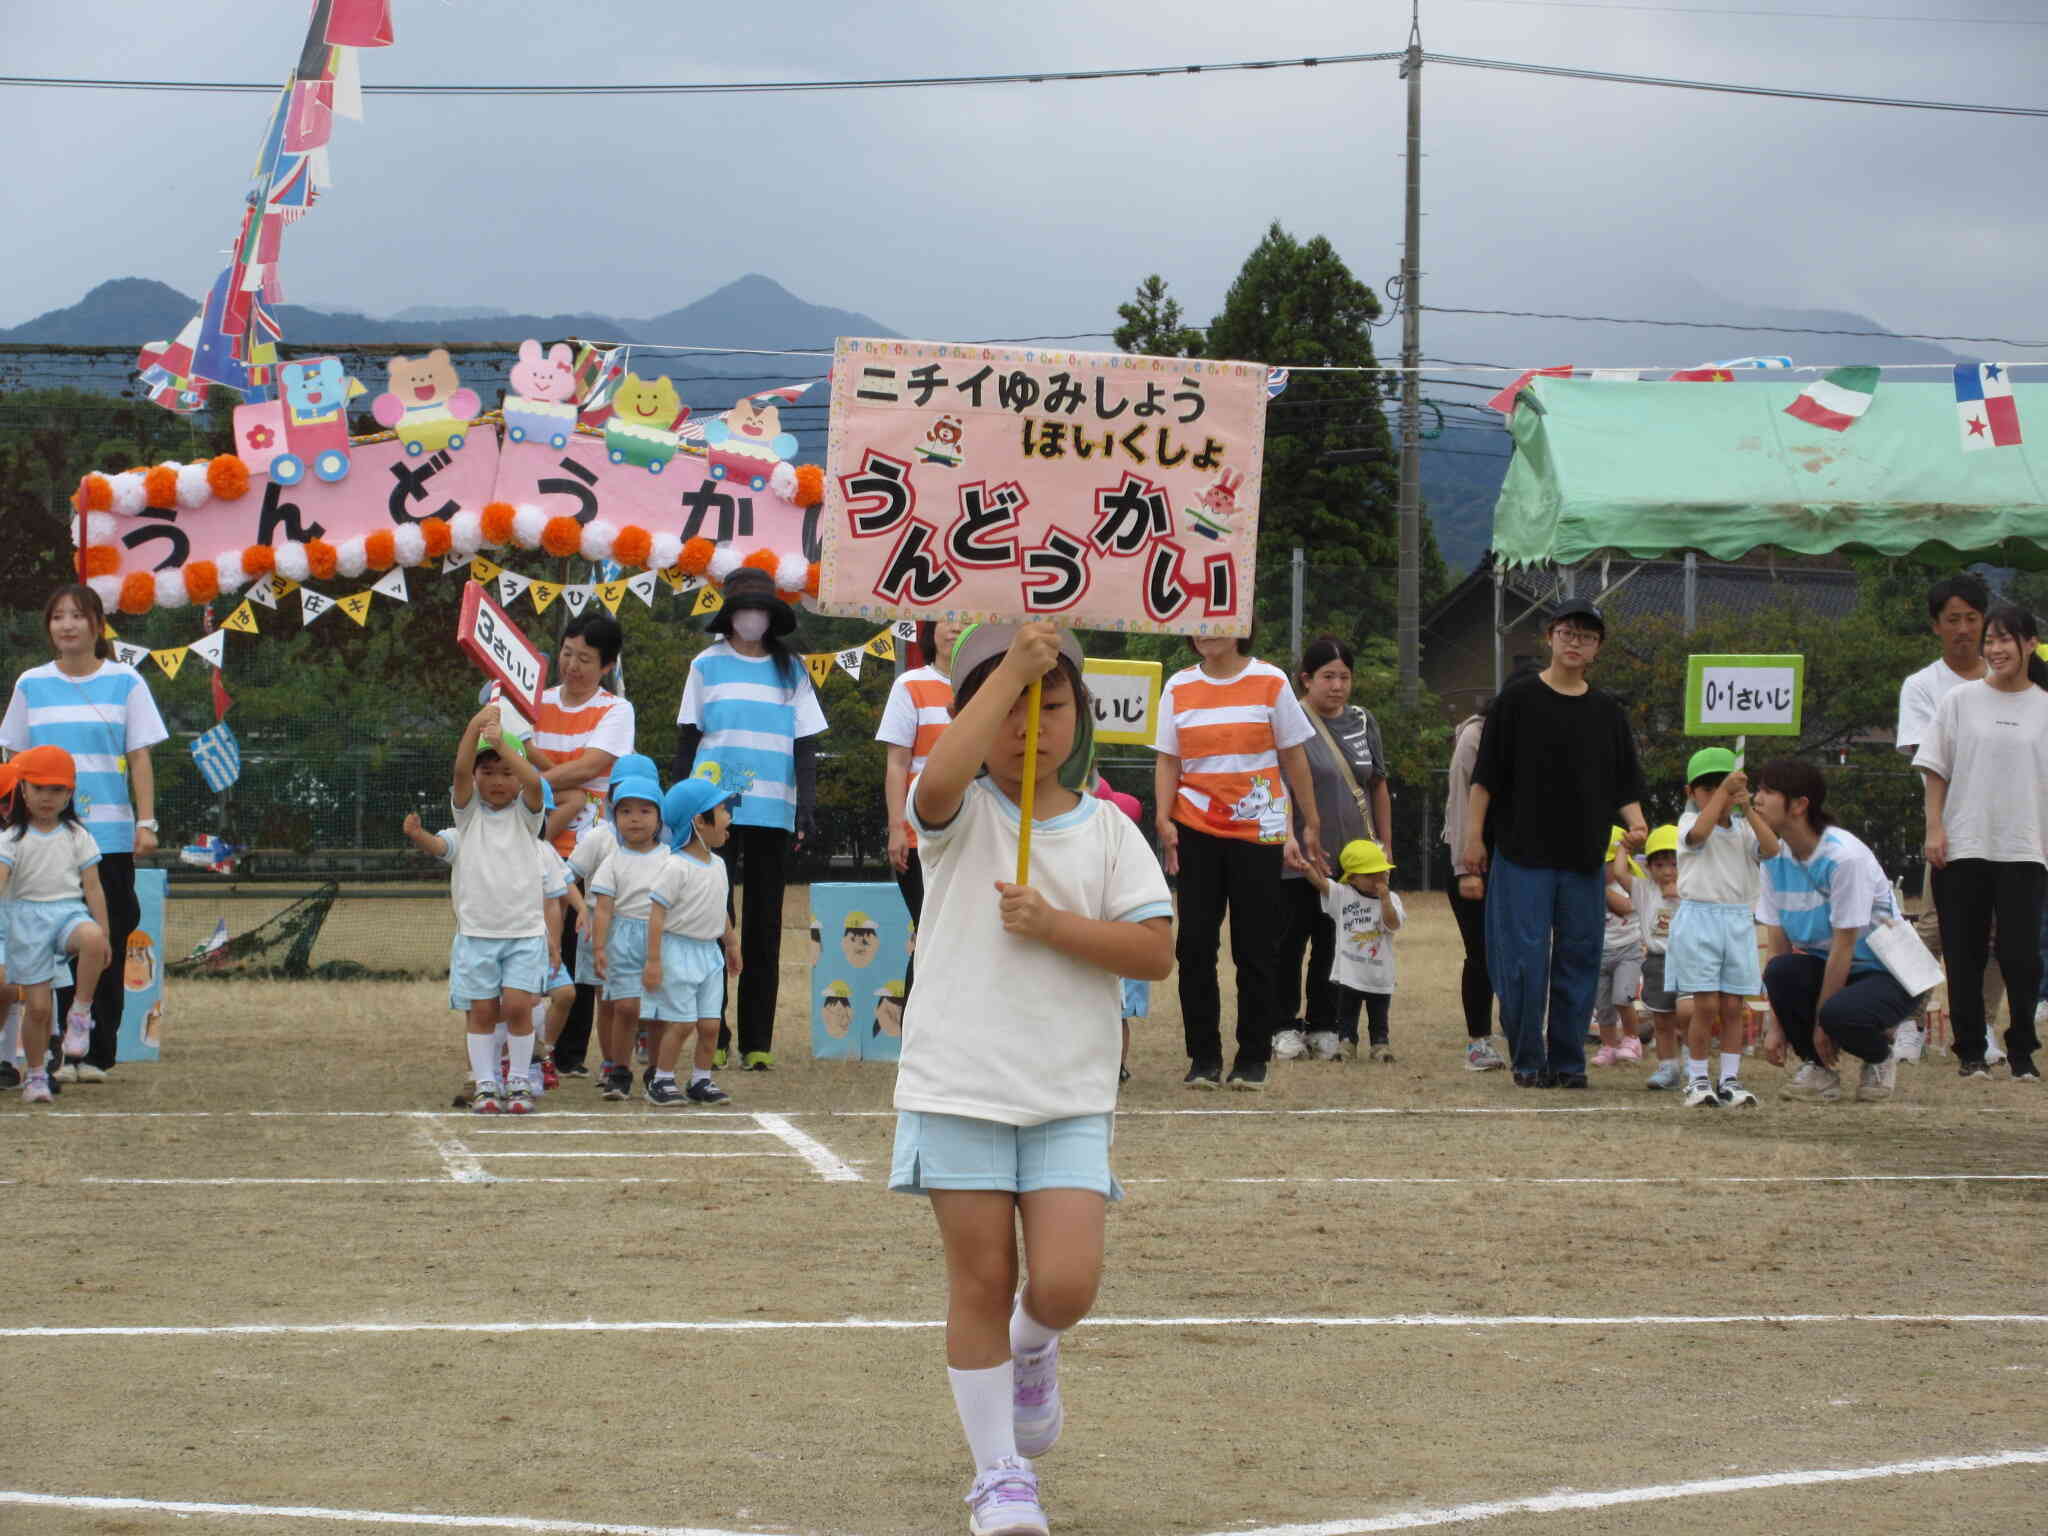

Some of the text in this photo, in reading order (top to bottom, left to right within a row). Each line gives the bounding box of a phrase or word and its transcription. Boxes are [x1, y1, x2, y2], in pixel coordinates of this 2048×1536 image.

[857, 363, 1206, 423] ニチイゆみしょう
[1022, 418, 1225, 470] ほいくしょ
[839, 447, 1237, 623] うんどうかい
[477, 609, 535, 691] 3さいじ
[1089, 695, 1144, 722] いじ
